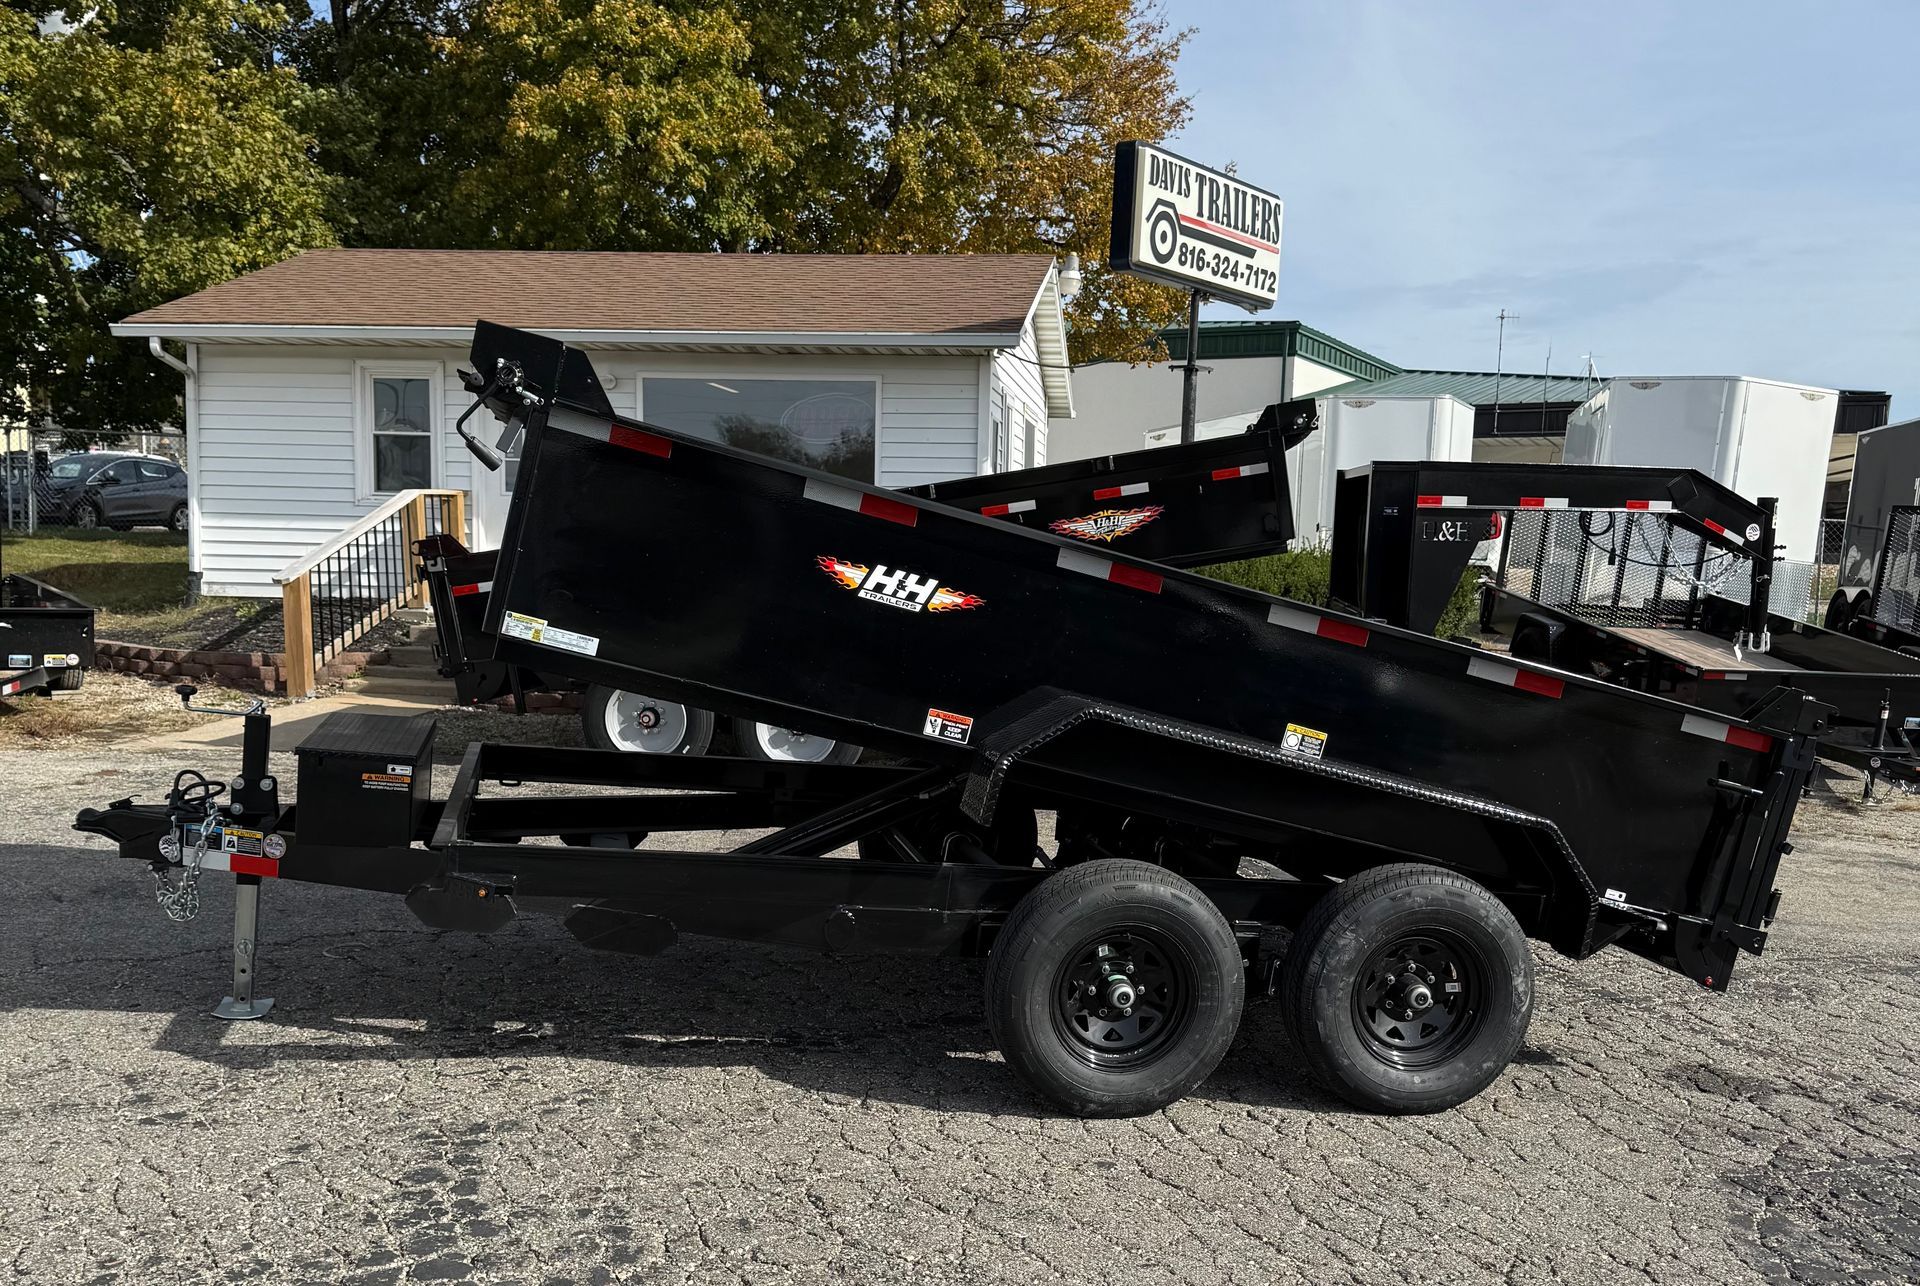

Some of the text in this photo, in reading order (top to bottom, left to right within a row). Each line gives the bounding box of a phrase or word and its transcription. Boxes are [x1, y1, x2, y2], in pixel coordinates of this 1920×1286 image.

[1148, 154, 1281, 245] DAVIS TRAILERS
[1178, 242, 1277, 294] 816-324-7172
[862, 564, 939, 604] H&H
[863, 591, 917, 610] TRAILERS
[944, 731, 962, 739] CLEAR
